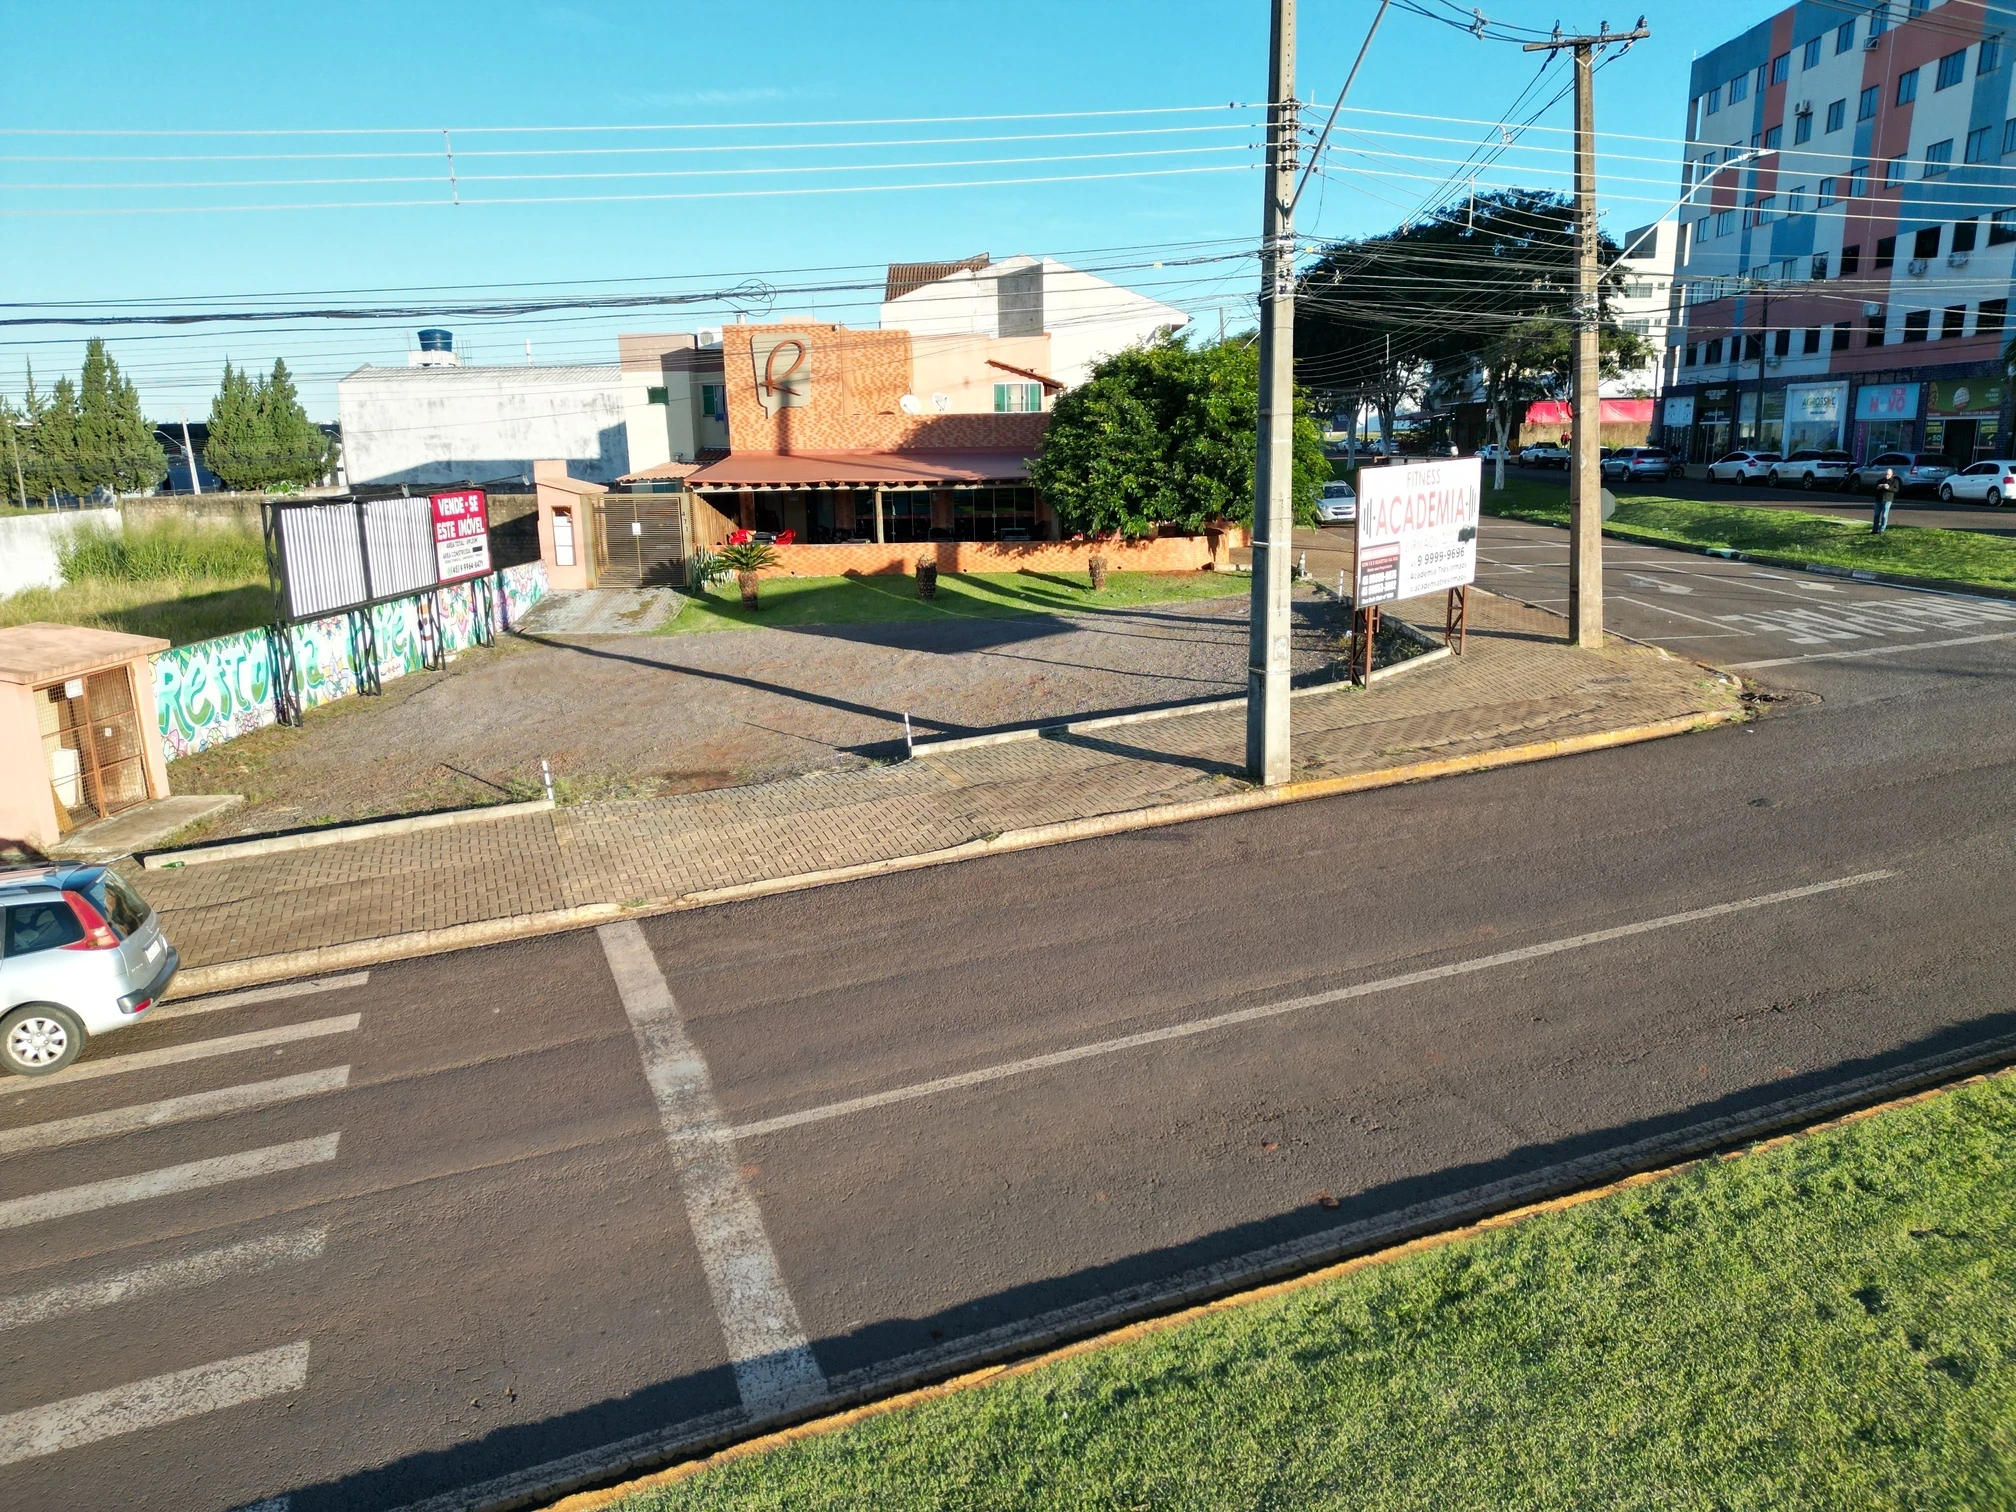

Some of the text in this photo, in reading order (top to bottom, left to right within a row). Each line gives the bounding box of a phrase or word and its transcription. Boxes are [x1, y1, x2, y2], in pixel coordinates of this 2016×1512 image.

[1407, 469, 1441, 487] FITNESS
[1376, 488, 1465, 536] ACADEMIA
[437, 514, 485, 540] ESTE IMÓVEL
[1424, 547, 1465, 565] 9999-9696
